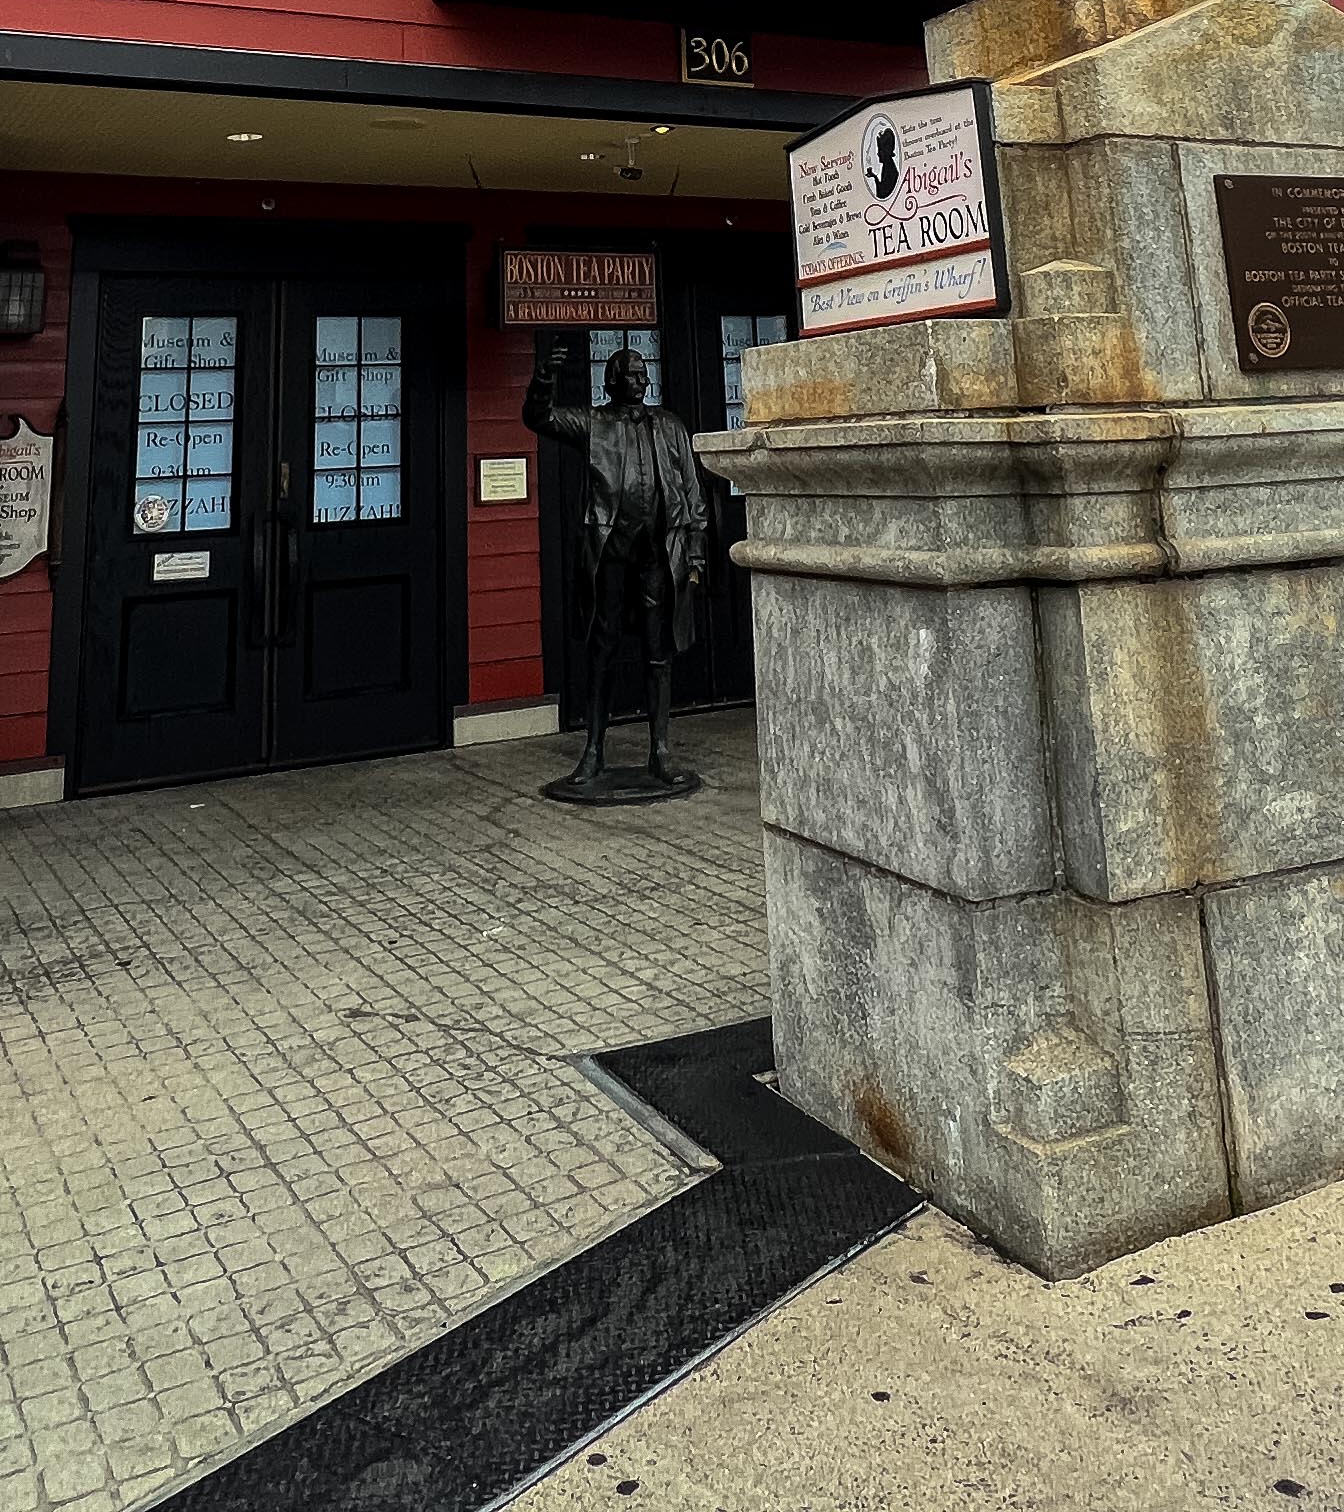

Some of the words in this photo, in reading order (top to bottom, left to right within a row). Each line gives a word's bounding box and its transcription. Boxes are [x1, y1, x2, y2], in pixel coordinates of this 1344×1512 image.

[690, 36, 750, 76] 306
[798, 161, 819, 179] Now
[900, 151, 973, 196] Abigail's
[867, 220, 912, 258] TEA
[918, 200, 988, 248] ROOM
[1272, 217, 1294, 229] THE
[1281, 242, 1325, 254] BOSTON
[506, 253, 566, 284] BOSTON
[568, 254, 601, 284] TEA
[603, 255, 652, 285] PARTY
[1245, 270, 1286, 282] BOSTON
[1288, 271, 1306, 281] TEA
[1309, 270, 1337, 281] PARTY
[810, 292, 834, 314] Best
[837, 286, 865, 308] View
[867, 289, 879, 302] on
[883, 269, 930, 305] Griffin's
[933, 257, 988, 299] Wharf!
[1281, 295, 1325, 307] OFFICIAL
[1326, 295, 1344, 307] TEA
[508, 303, 515, 320] A
[517, 302, 595, 320] REVOLUTIONARY
[597, 302, 652, 321] EXPERIENCE
[219, 331, 235, 348] &
[590, 331, 642, 346] Musem
[385, 346, 399, 361] &
[317, 368, 347, 384] Gift
[137, 391, 234, 413] CLOSED
[146, 430, 223, 450] Re-Open
[0, 504, 37, 523] Shop
